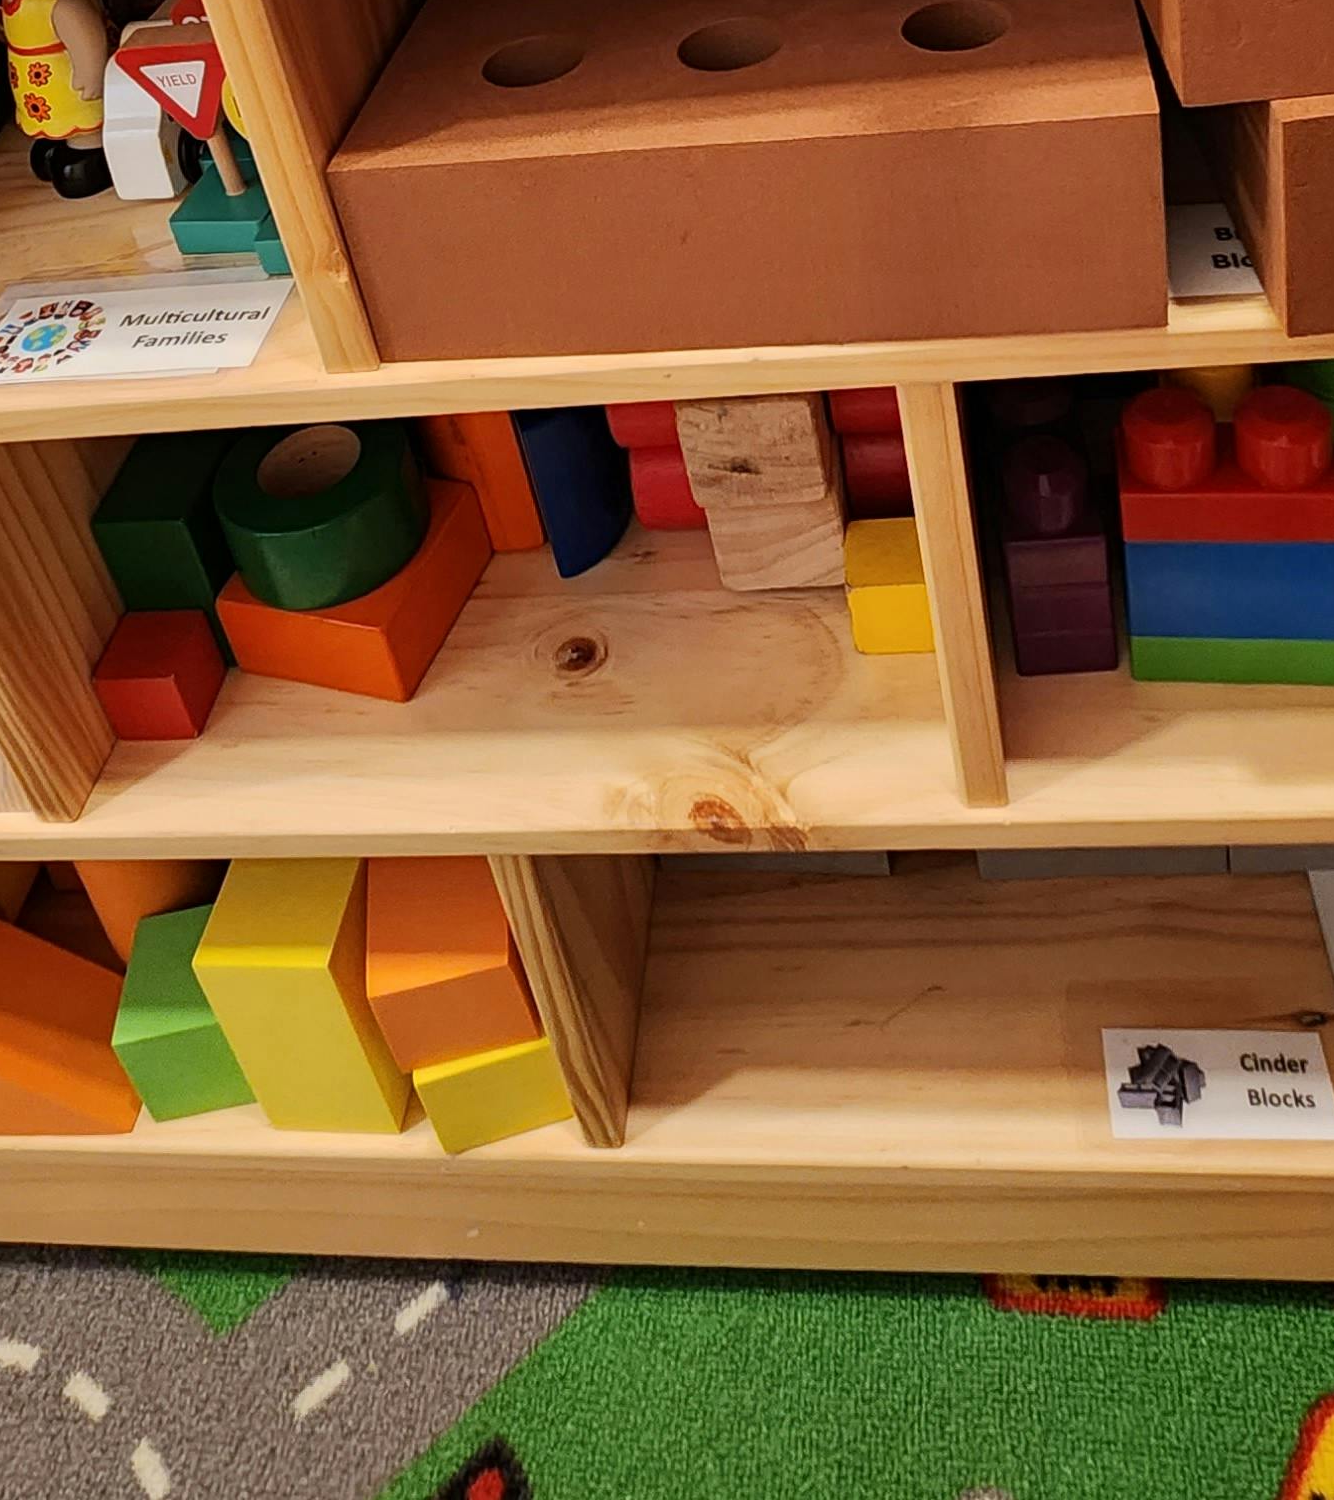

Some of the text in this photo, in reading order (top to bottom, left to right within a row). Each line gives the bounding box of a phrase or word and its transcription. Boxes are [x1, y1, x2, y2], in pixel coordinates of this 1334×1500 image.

[156, 73, 197, 89] YIELD
[119, 305, 271, 329] Multicultural
[131, 331, 229, 350] Families
[1239, 1052, 1309, 1074] Cinder
[1247, 1087, 1316, 1108] Blocks
